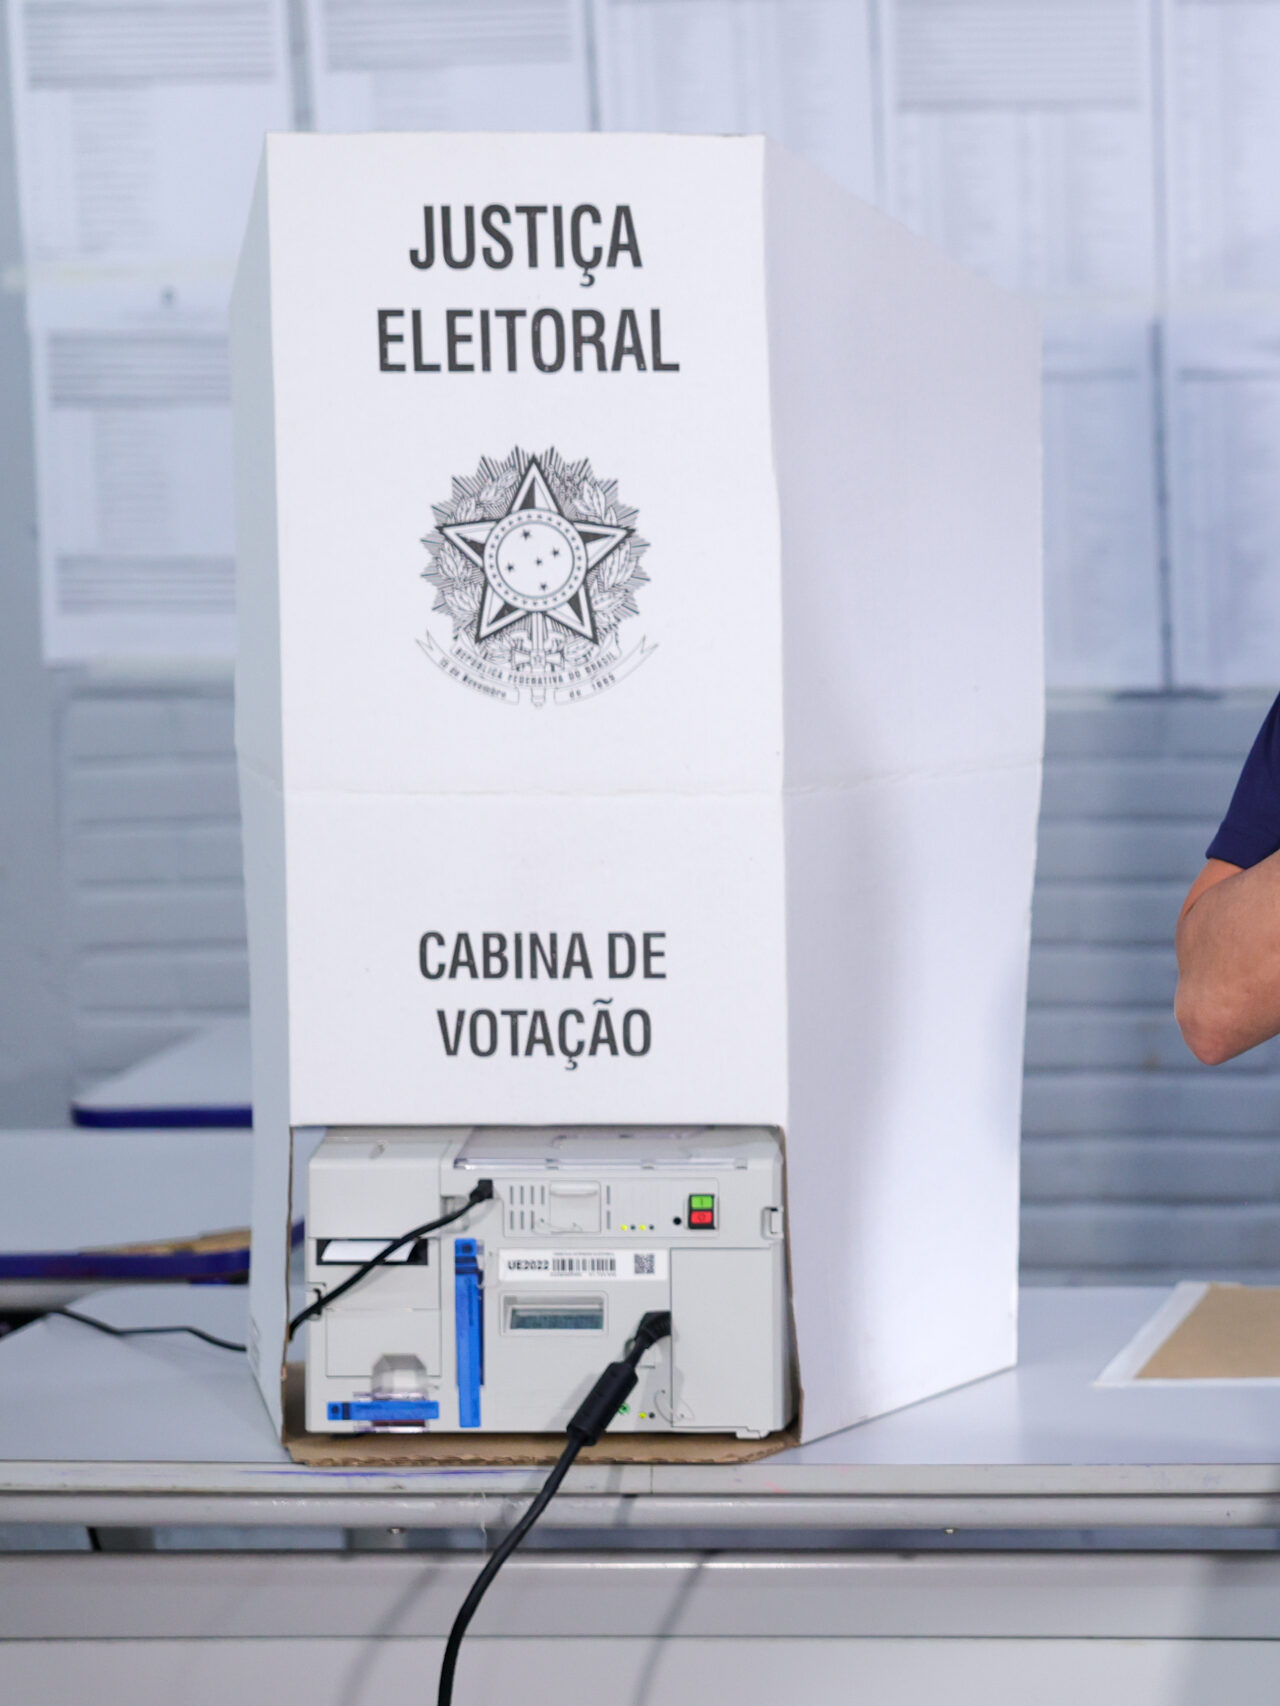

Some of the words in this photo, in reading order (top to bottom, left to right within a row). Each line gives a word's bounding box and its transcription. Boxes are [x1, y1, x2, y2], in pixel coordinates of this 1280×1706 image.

[409, 204, 643, 287] JUSTIÇA
[376, 308, 680, 373] ELEITORAL
[585, 651, 617, 674] BRASIL
[418, 931, 594, 980] CABINA
[608, 932, 667, 979] DE
[436, 997, 652, 1071] VOTAÇÃO
[507, 1259, 549, 1271] UE2022
